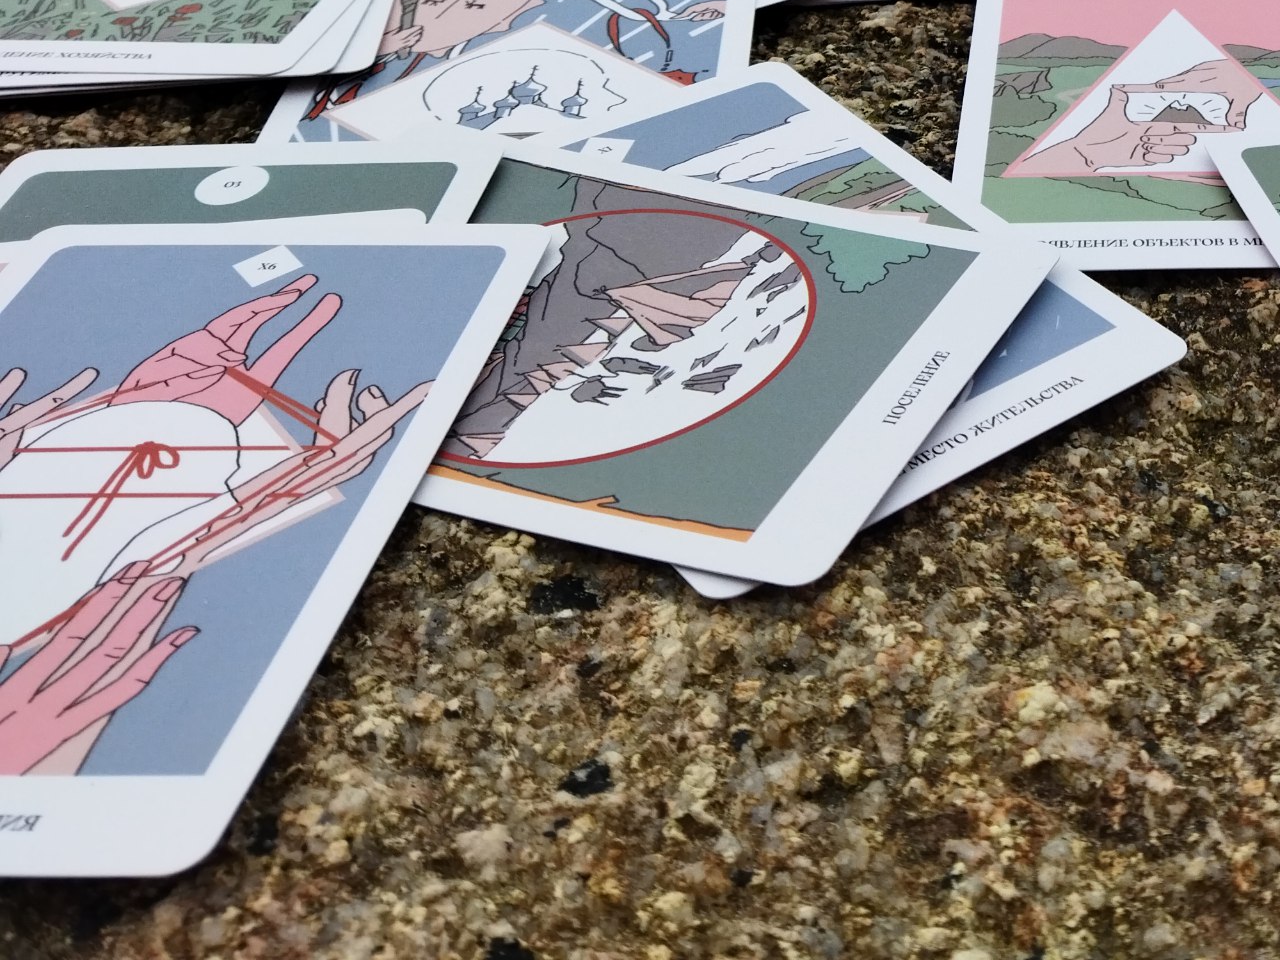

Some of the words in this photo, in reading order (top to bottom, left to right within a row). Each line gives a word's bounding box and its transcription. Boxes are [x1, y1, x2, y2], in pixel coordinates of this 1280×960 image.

[57, 51, 153, 59] ХОЗЯЙСТВА
[1132, 237, 1224, 248] ОБЪЕКТОВ
[1229, 238, 1239, 246] В
[882, 350, 950, 425] ПОСЕЛЕНИЕ
[907, 433, 968, 470] МЕСТО
[968, 376, 1085, 437] ЖИТЕЛЬСТВА
